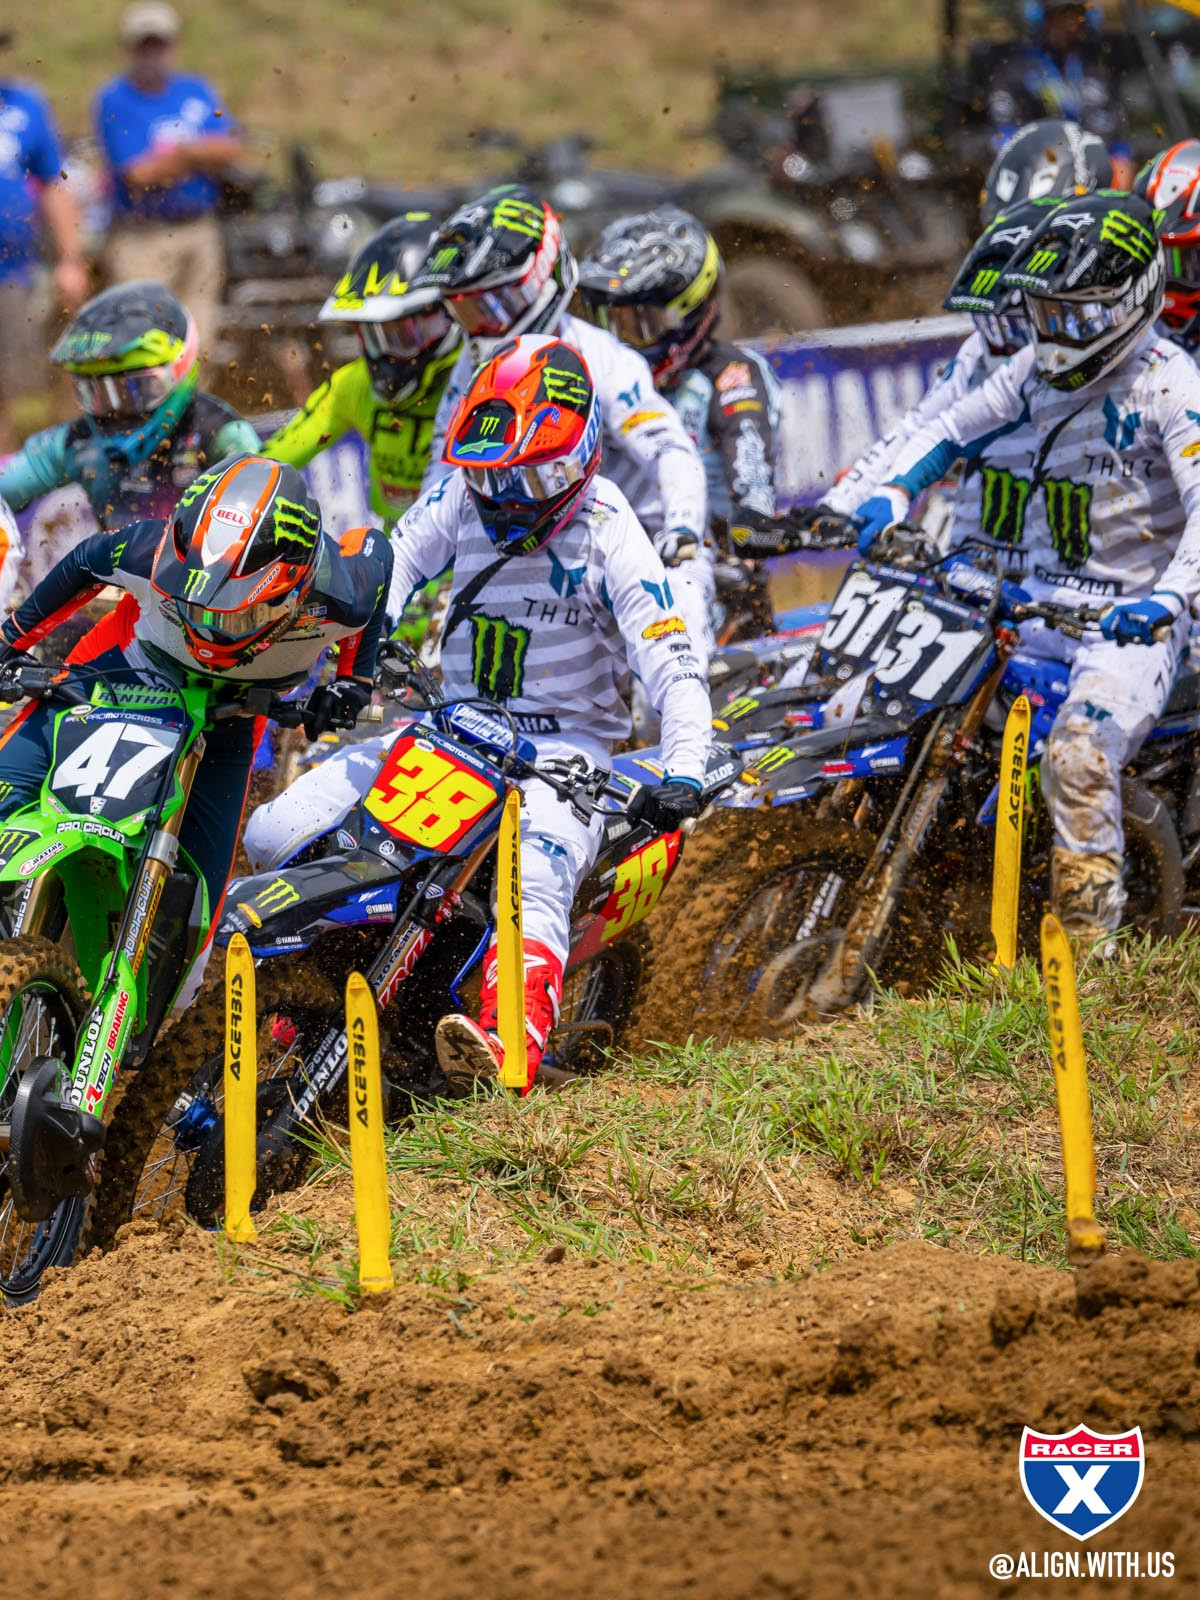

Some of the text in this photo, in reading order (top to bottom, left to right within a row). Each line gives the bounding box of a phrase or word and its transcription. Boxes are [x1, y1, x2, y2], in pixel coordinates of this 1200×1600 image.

[216, 508, 246, 526] BELL
[873, 609, 986, 701] 31
[51, 721, 182, 801] 47
[363, 744, 499, 849] 38
[1007, 731, 1026, 832] ACERBIS
[33, 841, 63, 865] MAXIMA
[56, 822, 81, 834] PRO
[600, 838, 669, 944] 38
[71, 1006, 104, 1107] DUNLOP
[107, 990, 130, 1051] BRAKING
[230, 973, 243, 1082] ACERBIS
[1048, 957, 1067, 1071] ACERBIS
[294, 1033, 349, 1121] DUNLO
[352, 1016, 369, 1128] ACERBIS
